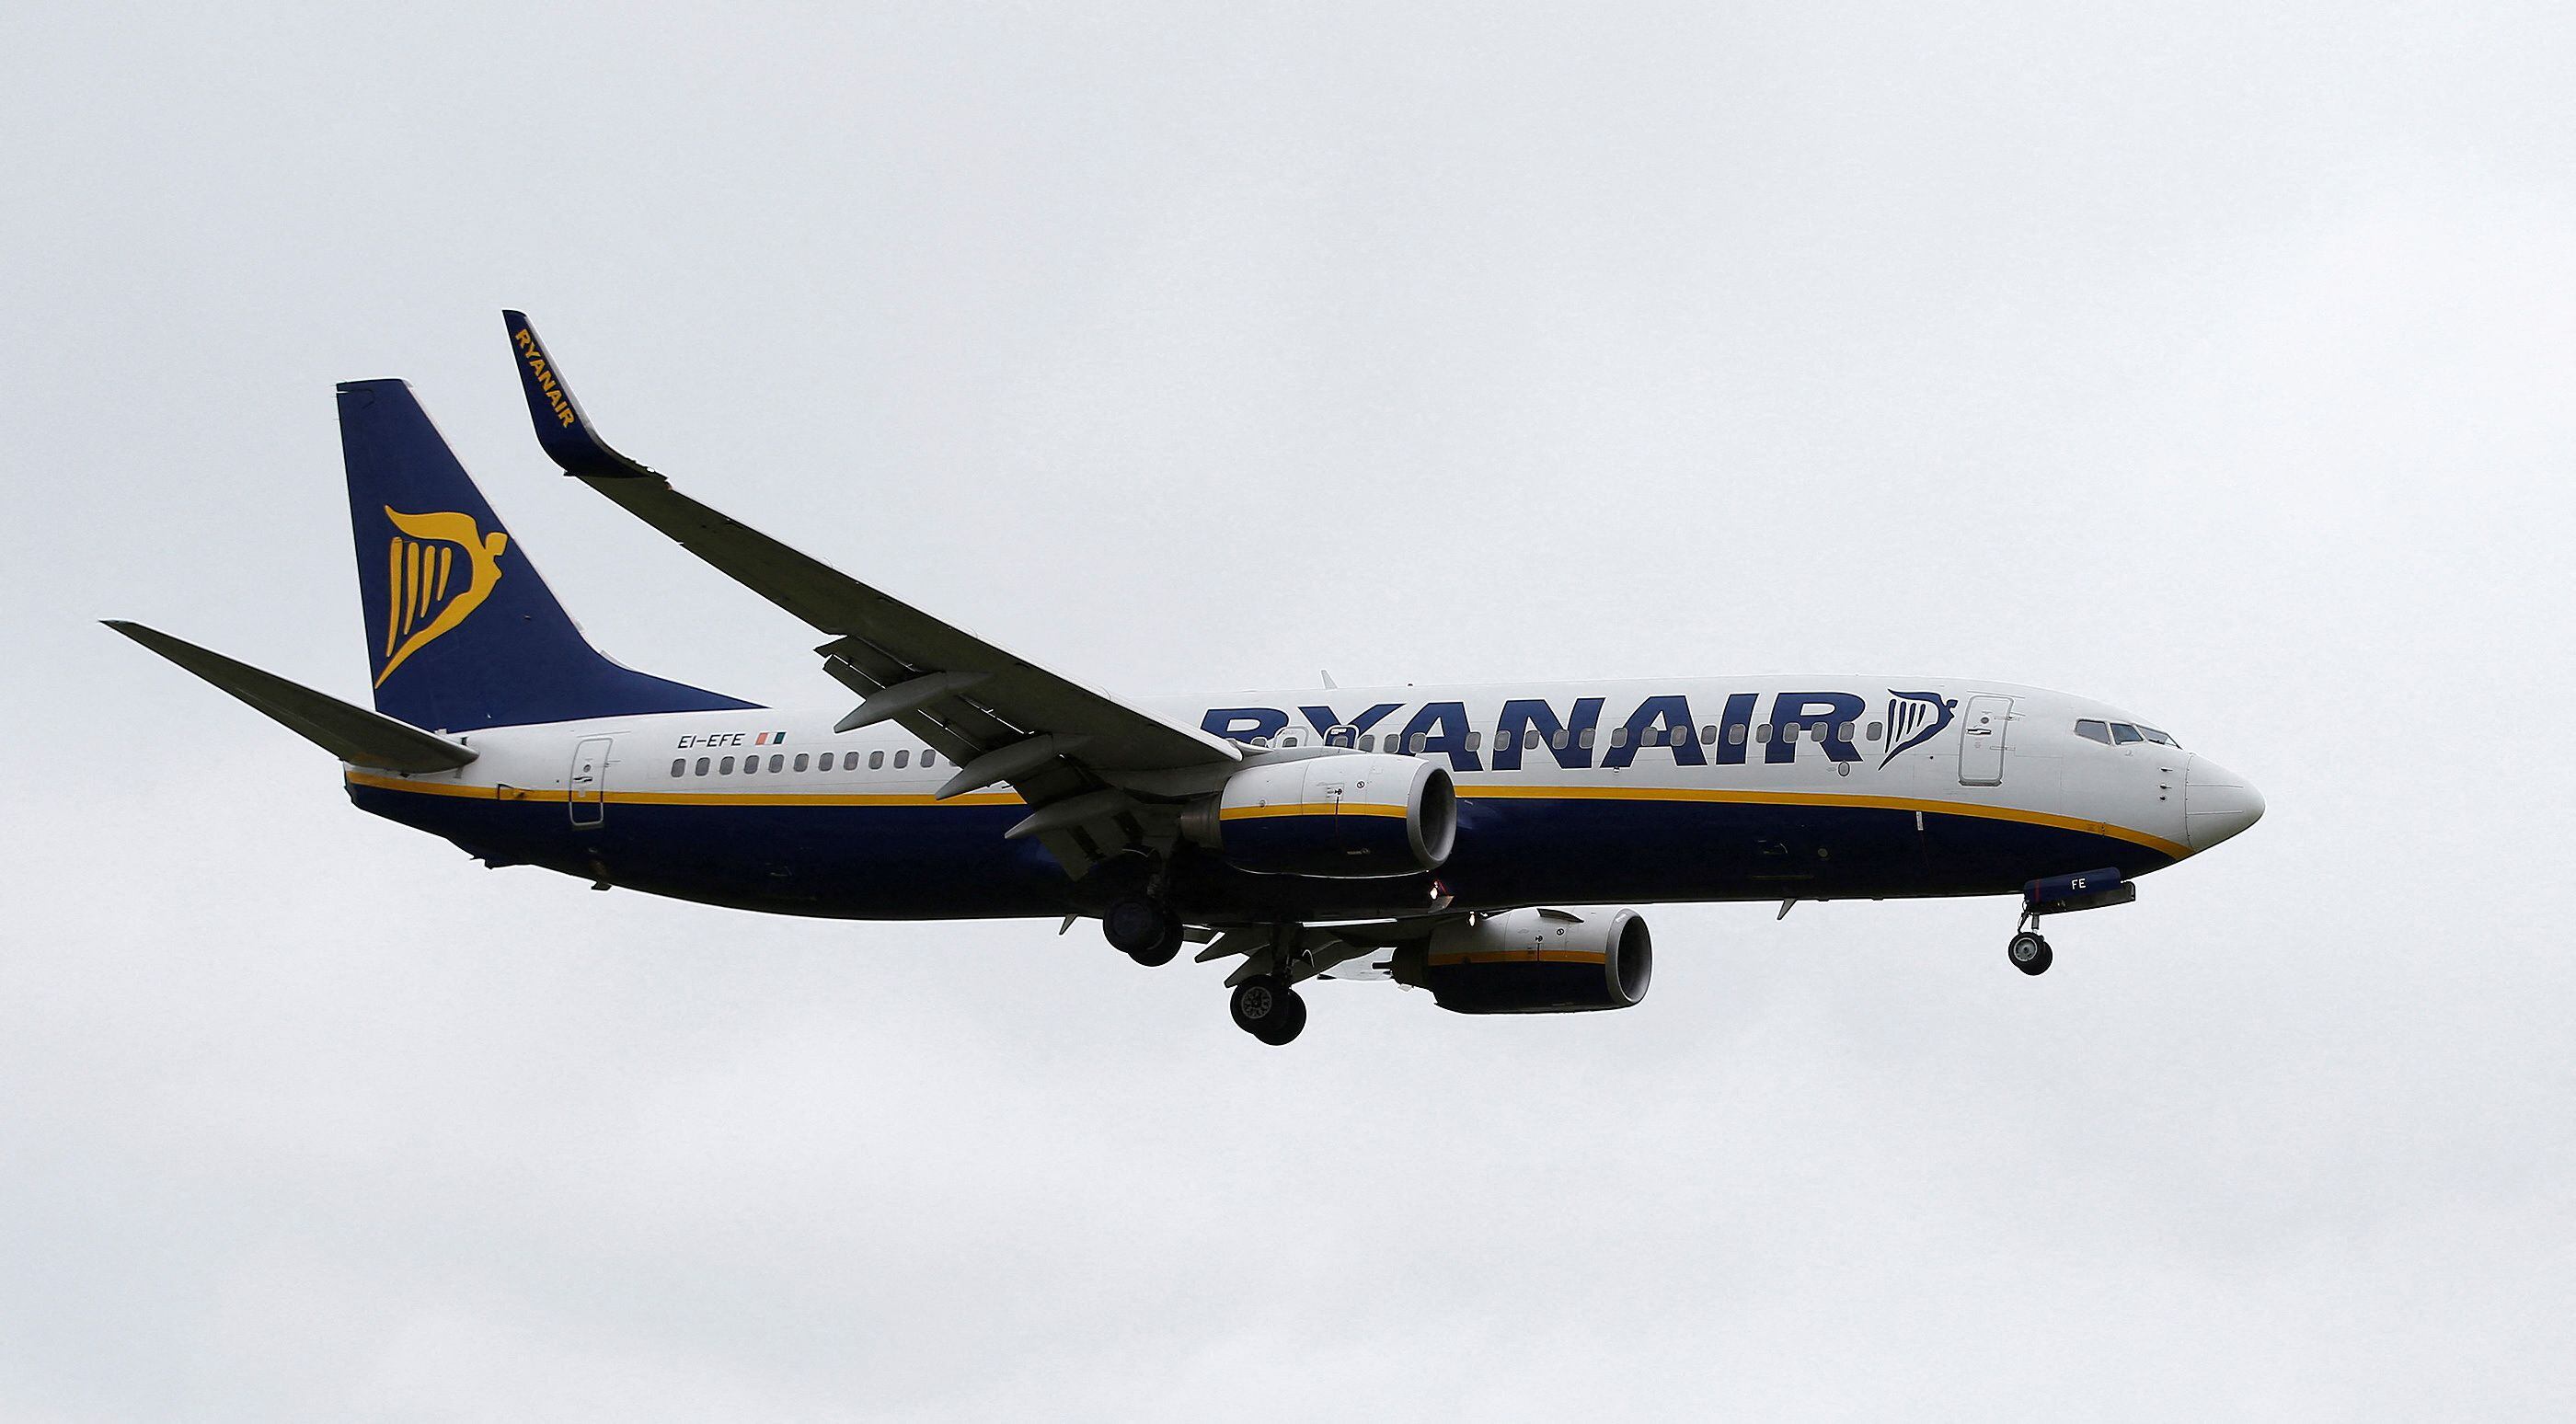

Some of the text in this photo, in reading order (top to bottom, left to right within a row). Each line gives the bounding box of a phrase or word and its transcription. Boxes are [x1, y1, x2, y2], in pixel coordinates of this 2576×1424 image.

[515, 328, 575, 429] RYANAIR
[677, 732, 746, 750] EI-EFE
[2071, 878, 2087, 890] FE
